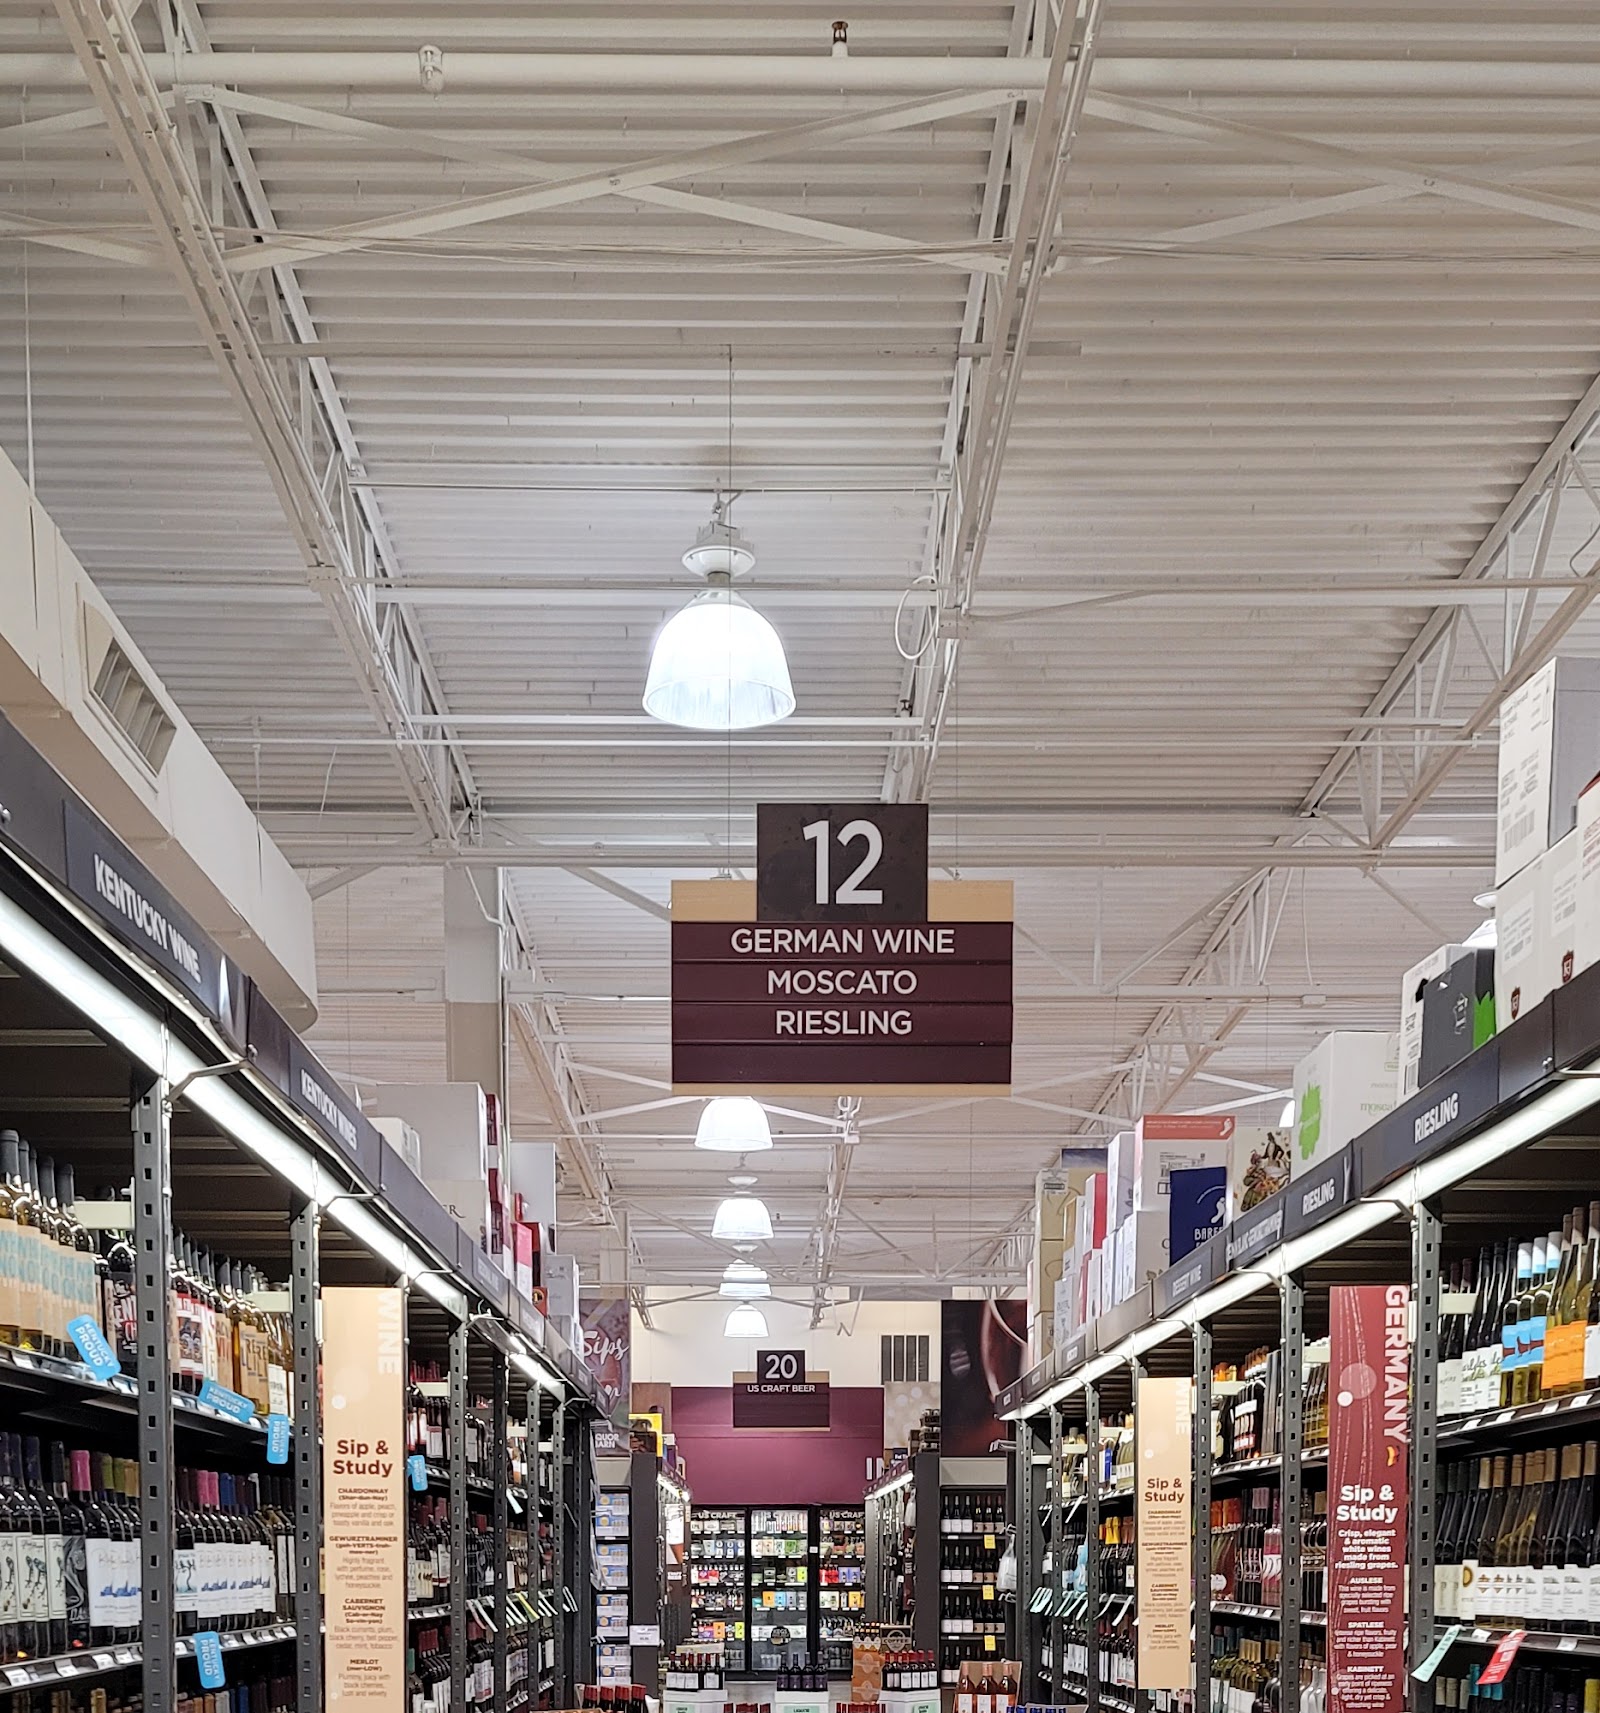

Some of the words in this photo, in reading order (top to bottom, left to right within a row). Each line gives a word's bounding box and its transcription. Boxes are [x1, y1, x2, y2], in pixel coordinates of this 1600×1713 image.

[802, 819, 884, 905] 12
[94, 853, 168, 950] KENTUCKY
[168, 924, 201, 983] WINE
[731, 928, 863, 954] GERMAN
[872, 928, 955, 954] WINE
[768, 969, 918, 995] MOSCATO
[776, 1009, 913, 1035] RIESLING
[1414, 1092, 1459, 1145] RIESLING
[1302, 1178, 1335, 1216] RIESLING
[84, 1322, 115, 1367] KENTUCKY
[377, 1290, 400, 1375] WINE
[75, 1327, 103, 1366] PROUD
[583, 1330, 630, 1366] Sips
[765, 1354, 798, 1379] 20
[1384, 1285, 1409, 1444] GERMANY
[209, 1387, 248, 1408] KENTUCKY
[747, 1384, 759, 1393] US
[761, 1384, 790, 1393] CRAFT
[792, 1384, 815, 1393] BEER
[206, 1393, 240, 1413] PROUD
[271, 1420, 280, 1453] PROUD
[337, 1439, 369, 1458] Sip
[376, 1440, 389, 1455] &
[595, 1433, 619, 1441] QUOR
[333, 1459, 393, 1478] Study
[1147, 1478, 1169, 1490] Sip
[1173, 1478, 1182, 1488] &
[1340, 1484, 1375, 1505] Sip
[1379, 1484, 1395, 1501] &
[1144, 1491, 1185, 1504] Study
[1336, 1504, 1398, 1524] Study
[1338, 1529, 1363, 1538] Crisp,
[1363, 1529, 1396, 1538] elegant
[1352, 1537, 1390, 1545] aromatic
[1335, 1561, 1366, 1570] riesling
[1367, 1562, 1399, 1570] grapes.
[1368, 1553, 1390, 1561] from
[200, 1639, 213, 1676] PROUD
